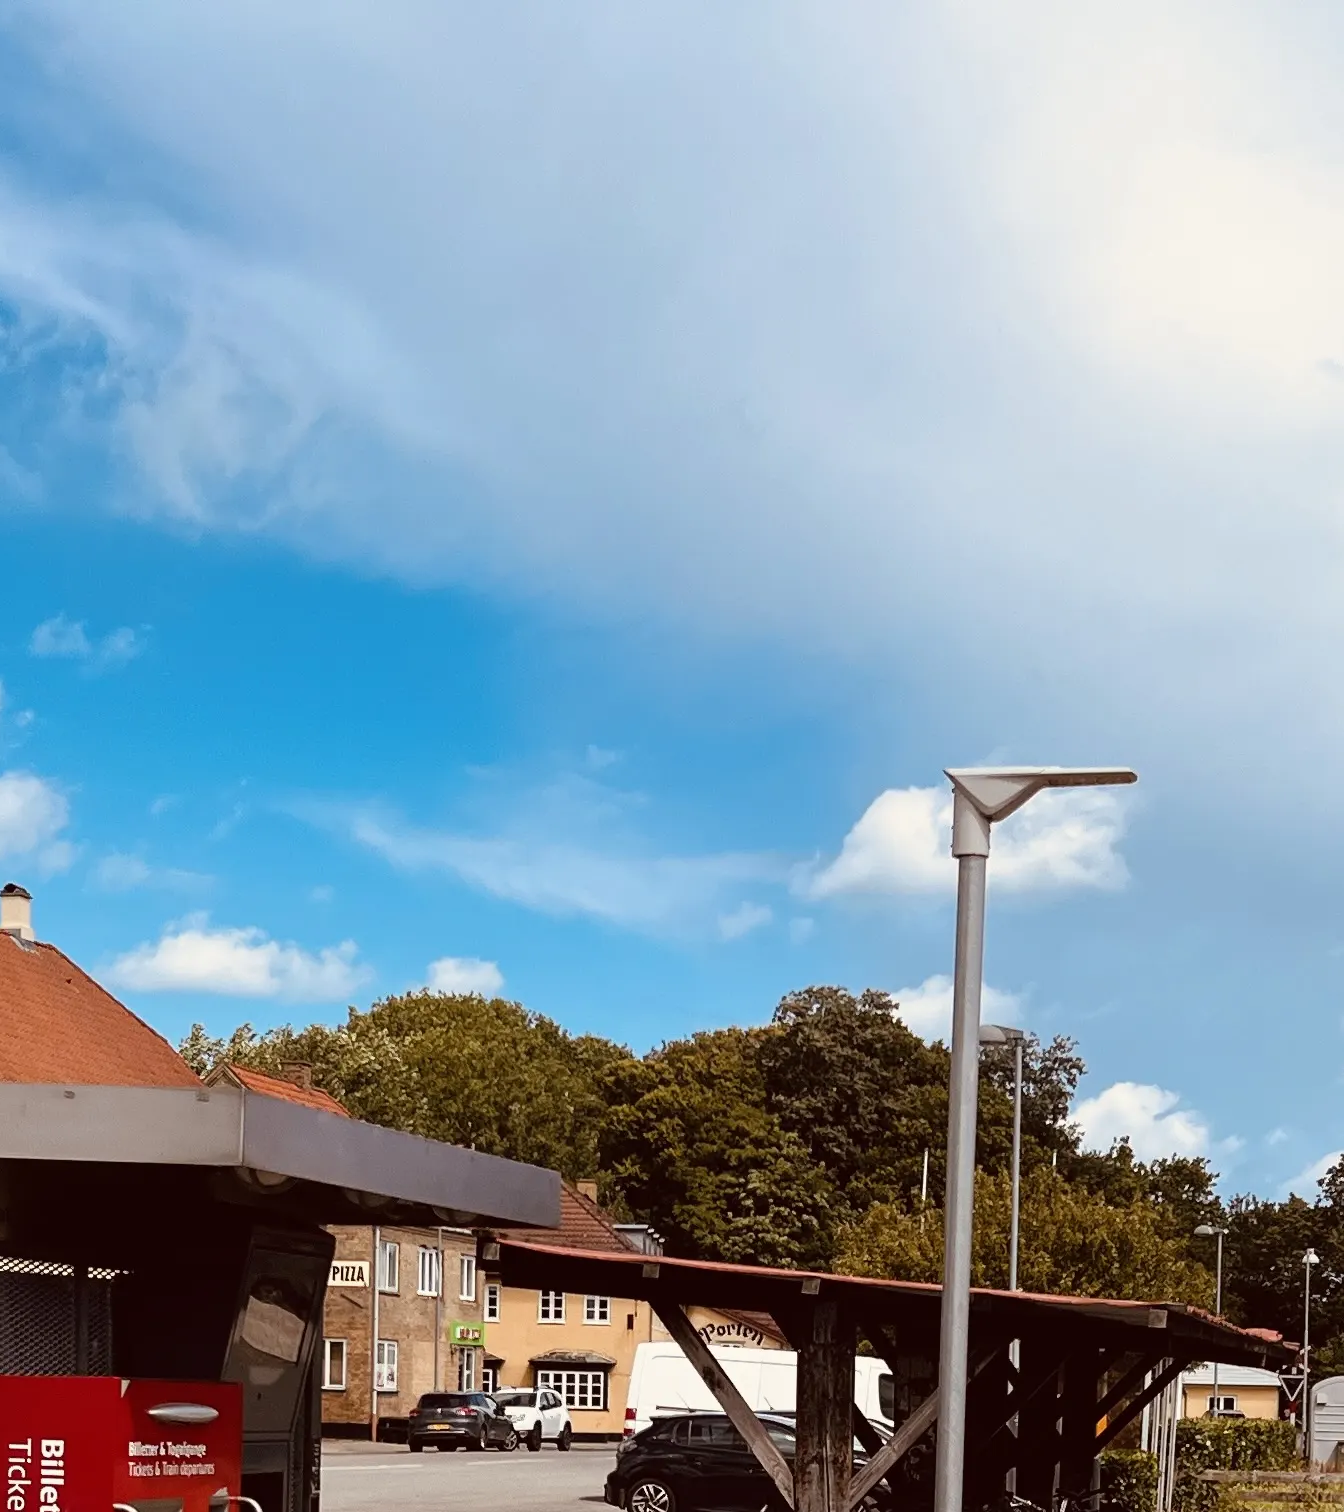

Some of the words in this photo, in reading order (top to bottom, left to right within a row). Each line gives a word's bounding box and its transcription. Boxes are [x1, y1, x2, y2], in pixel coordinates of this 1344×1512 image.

[332, 1265, 365, 1282] PIZZA
[128, 1461, 154, 1477] Tickets
[162, 1461, 179, 1476] Train
[179, 1461, 216, 1477] departures
